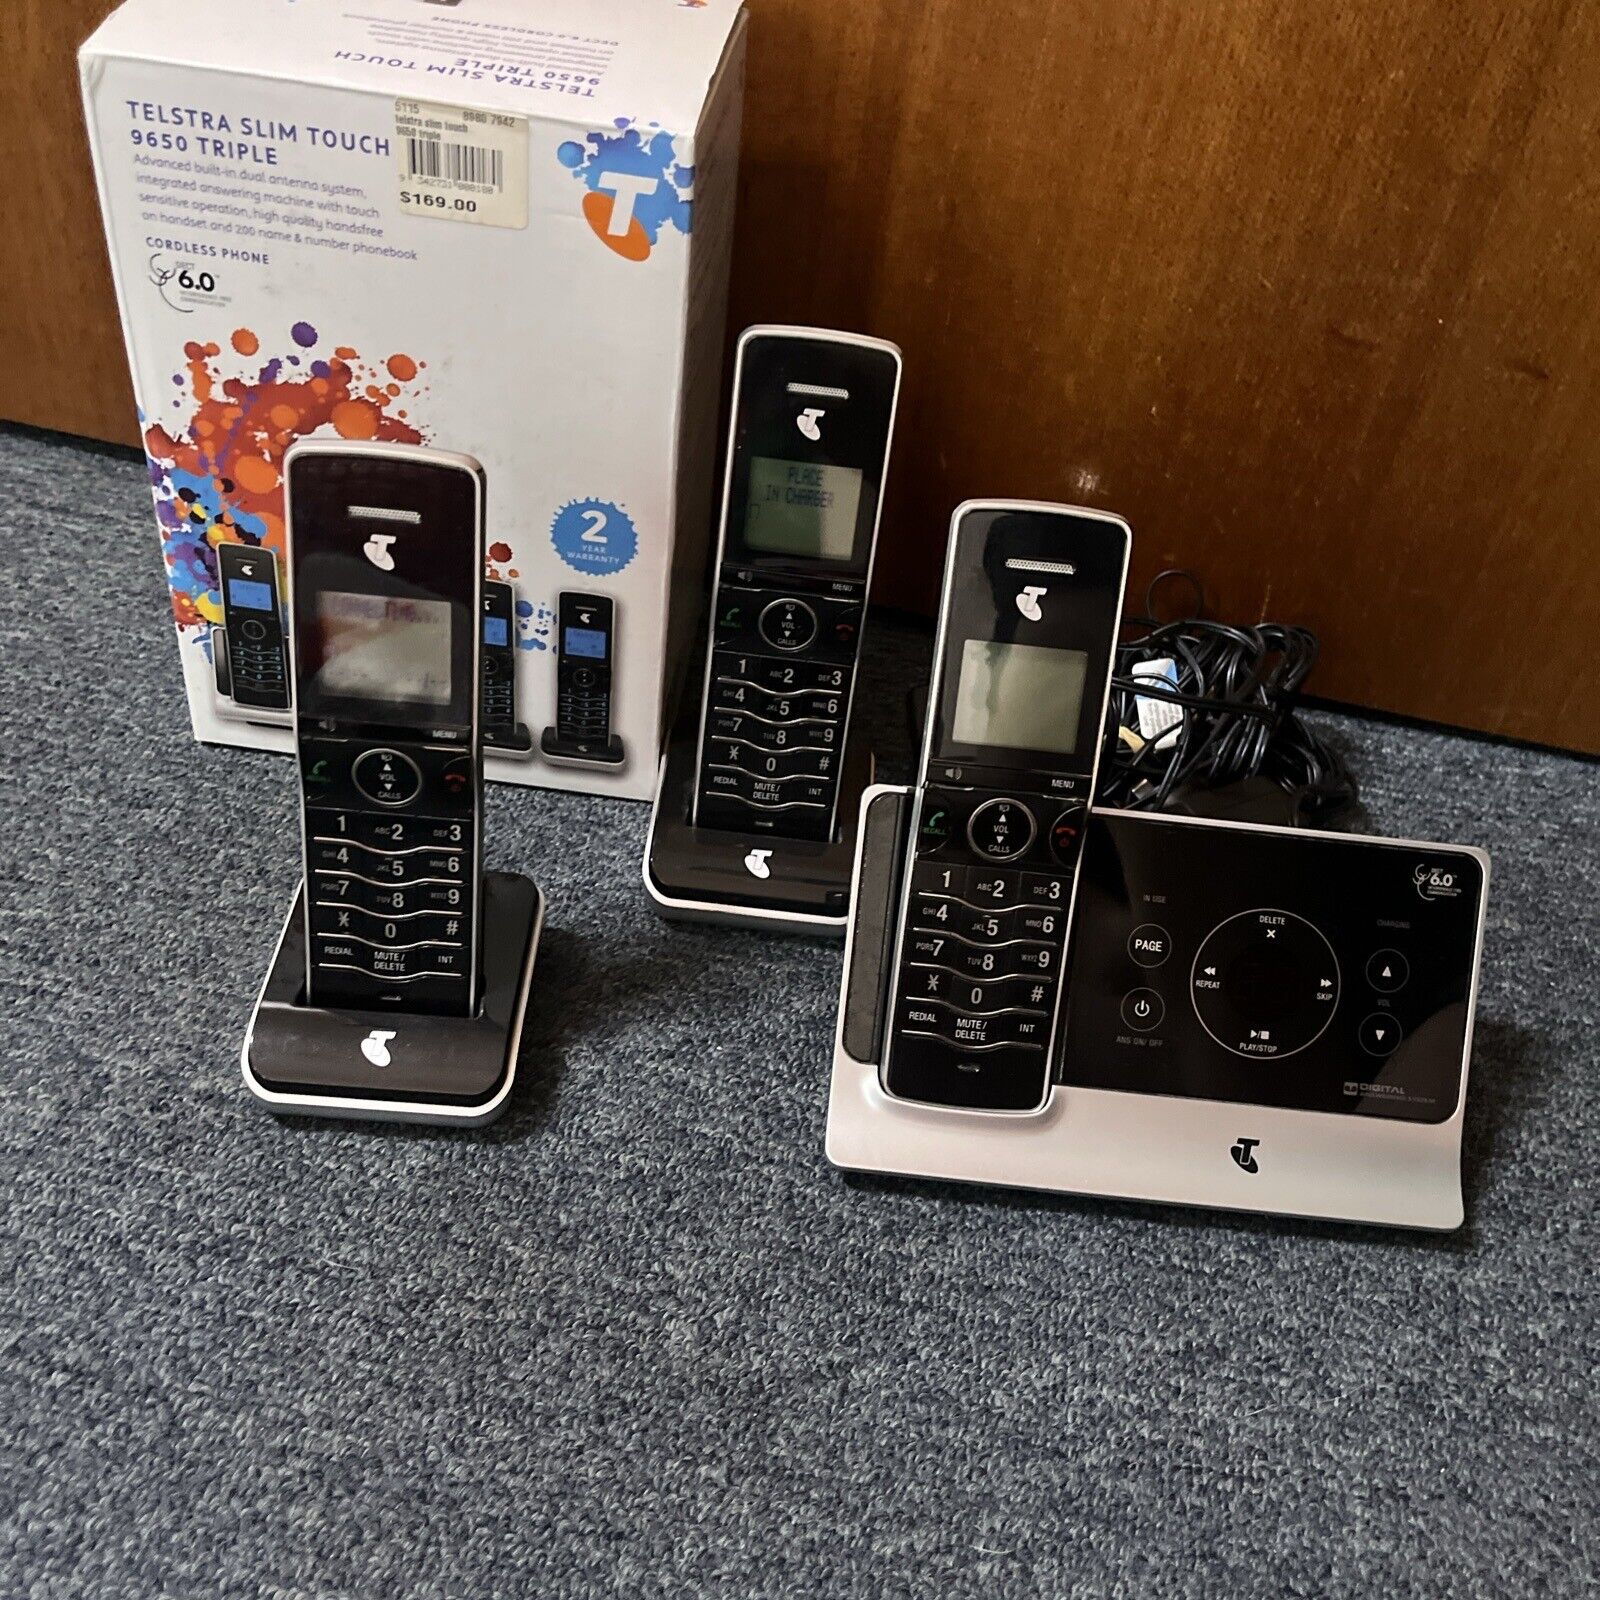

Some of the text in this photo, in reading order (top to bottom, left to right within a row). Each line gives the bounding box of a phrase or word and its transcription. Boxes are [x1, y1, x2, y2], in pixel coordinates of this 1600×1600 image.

[334, 51, 595, 97] TELSTRA SLIM TOUCH
[455, 58, 600, 86] 9650 TRIPLE
[126, 100, 390, 156] TELSTRA SLIM TOUCH
[131, 129, 278, 165] 9650 TRIPLE
[134, 154, 191, 171] Advanced
[194, 162, 236, 178] built-in
[239, 170, 266, 183] dual
[269, 174, 318, 191] antenna
[136, 172, 380, 218] integrated answering machine with touch
[400, 191, 477, 212] $169.00
[139, 192, 189, 208] sensitive
[253, 208, 279, 224] high
[282, 213, 323, 231] quality
[326, 220, 384, 238] handsfree
[142, 212, 418, 261] on handset and 200 name & number phonebook
[146, 236, 270, 264] CORDLESS PHONE
[178, 270, 215, 292] 6.0
[581, 510, 608, 543] 2
[583, 545, 606, 553] YEAR
[567, 551, 620, 564] WARRANTY
[832, 583, 853, 592] MENU
[738, 659, 746, 674] 1
[783, 668, 794, 683] 2
[831, 670, 842, 685] 3
[734, 687, 745, 702] 4
[779, 701, 790, 716] 5
[827, 699, 838, 714] 6
[733, 717, 743, 732] 7
[432, 730, 457, 739] MENU
[776, 730, 786, 745] 8
[824, 728, 834, 743] 9
[766, 757, 776, 772] 0
[379, 773, 396, 781] VOL
[713, 776, 738, 786] REDIAL
[1051, 779, 1075, 789] MENU
[753, 792, 780, 801] DELETE
[808, 788, 822, 796] INT
[337, 815, 346, 832] 1
[993, 825, 1009, 834] VOL
[391, 824, 403, 840] 2
[450, 824, 461, 841] 3
[337, 847, 349, 863] 4
[988, 844, 1010, 853] CALLS
[392, 860, 404, 876] 5
[447, 857, 460, 873] 6
[942, 870, 951, 888] 1
[1429, 873, 1453, 887] 6.0
[338, 880, 350, 896] 7
[976, 880, 1005, 897] ABC 2
[1033, 881, 1061, 899] DEF 3
[392, 892, 404, 908] 8
[448, 889, 460, 905] 9
[936, 904, 948, 921] 4
[1259, 915, 1286, 925] DELETE
[384, 923, 397, 939] 0
[986, 919, 998, 936] 5
[1042, 916, 1054, 933] 6
[324, 946, 354, 956] REDIAL
[933, 939, 945, 957] 7
[1134, 938, 1163, 952] PAGE
[374, 962, 406, 972] DELETE
[438, 956, 454, 964] INT
[982, 954, 994, 971] 8
[1038, 951, 1050, 968] 9
[1195, 979, 1221, 989] REPEAT
[971, 987, 983, 1004] 0
[1316, 992, 1333, 1001] SKIP
[908, 1011, 937, 1023] REDIAL
[955, 1030, 986, 1041] DELETE
[1019, 1023, 1035, 1033] INT
[1239, 1042, 1278, 1053] PLAY/STOP
[1359, 1083, 1405, 1095] DIGITAL
